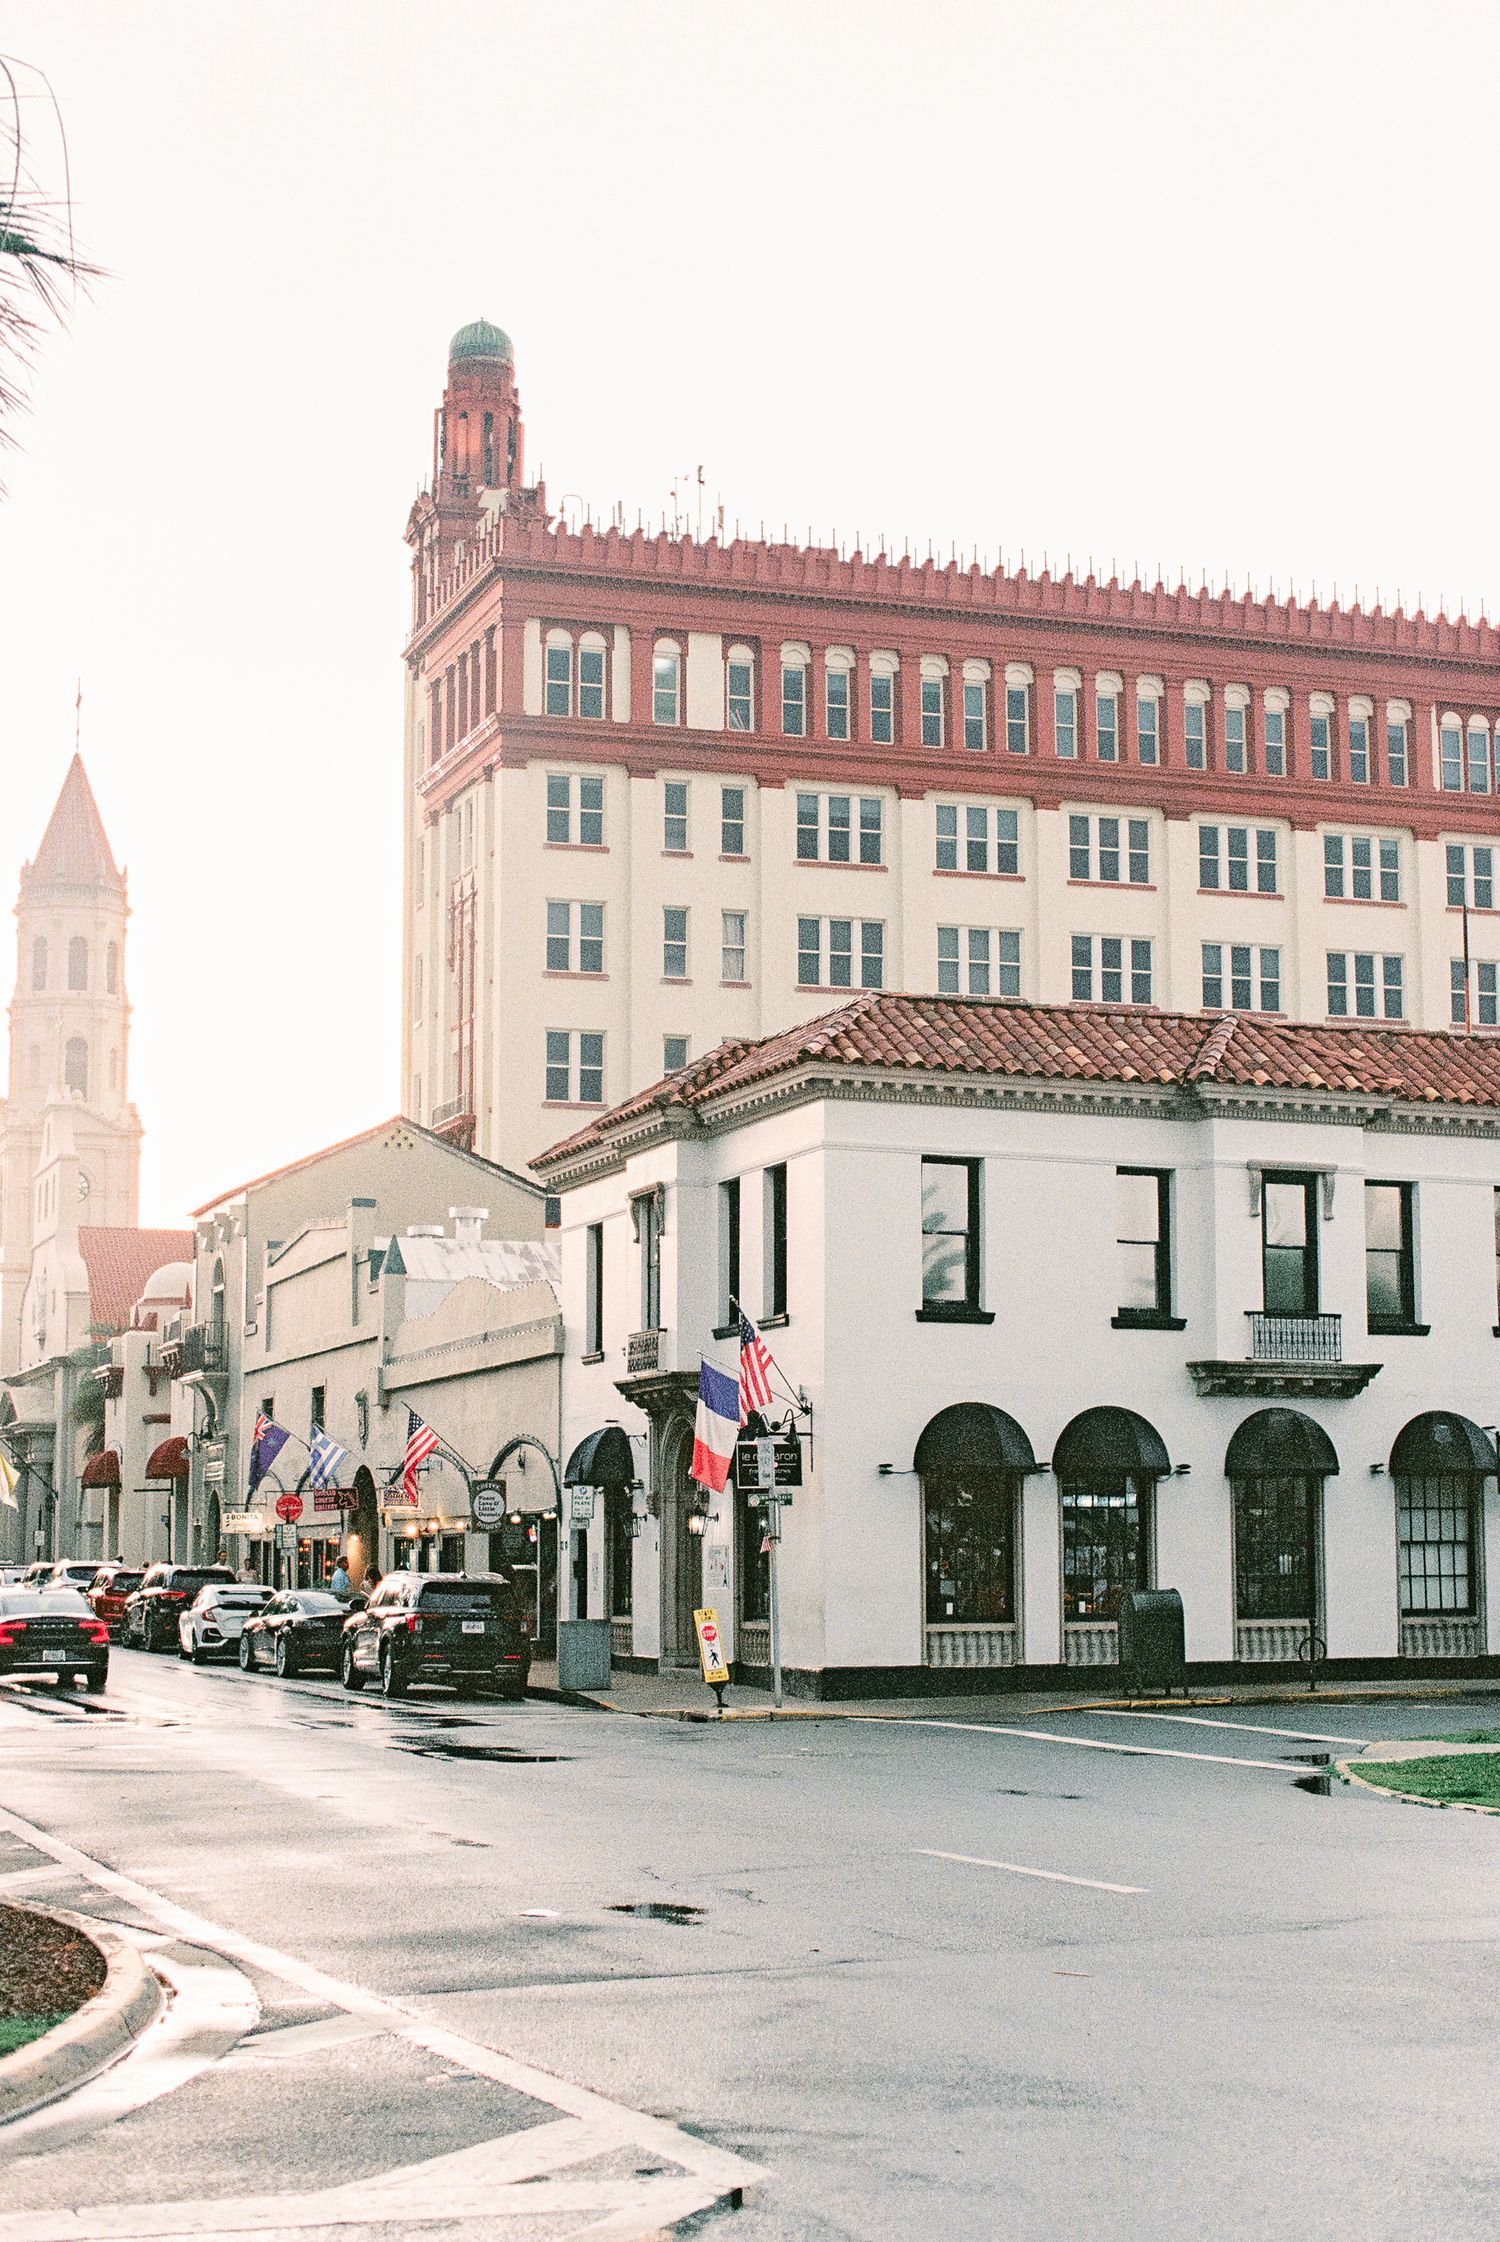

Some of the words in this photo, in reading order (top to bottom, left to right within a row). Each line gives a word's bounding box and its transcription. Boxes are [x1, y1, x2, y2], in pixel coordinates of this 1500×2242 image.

[742, 1453, 751, 1462] le
[753, 1453, 797, 1462] maron
[698, 1609, 714, 1617] STATE
[702, 1628, 718, 1638] STOP
